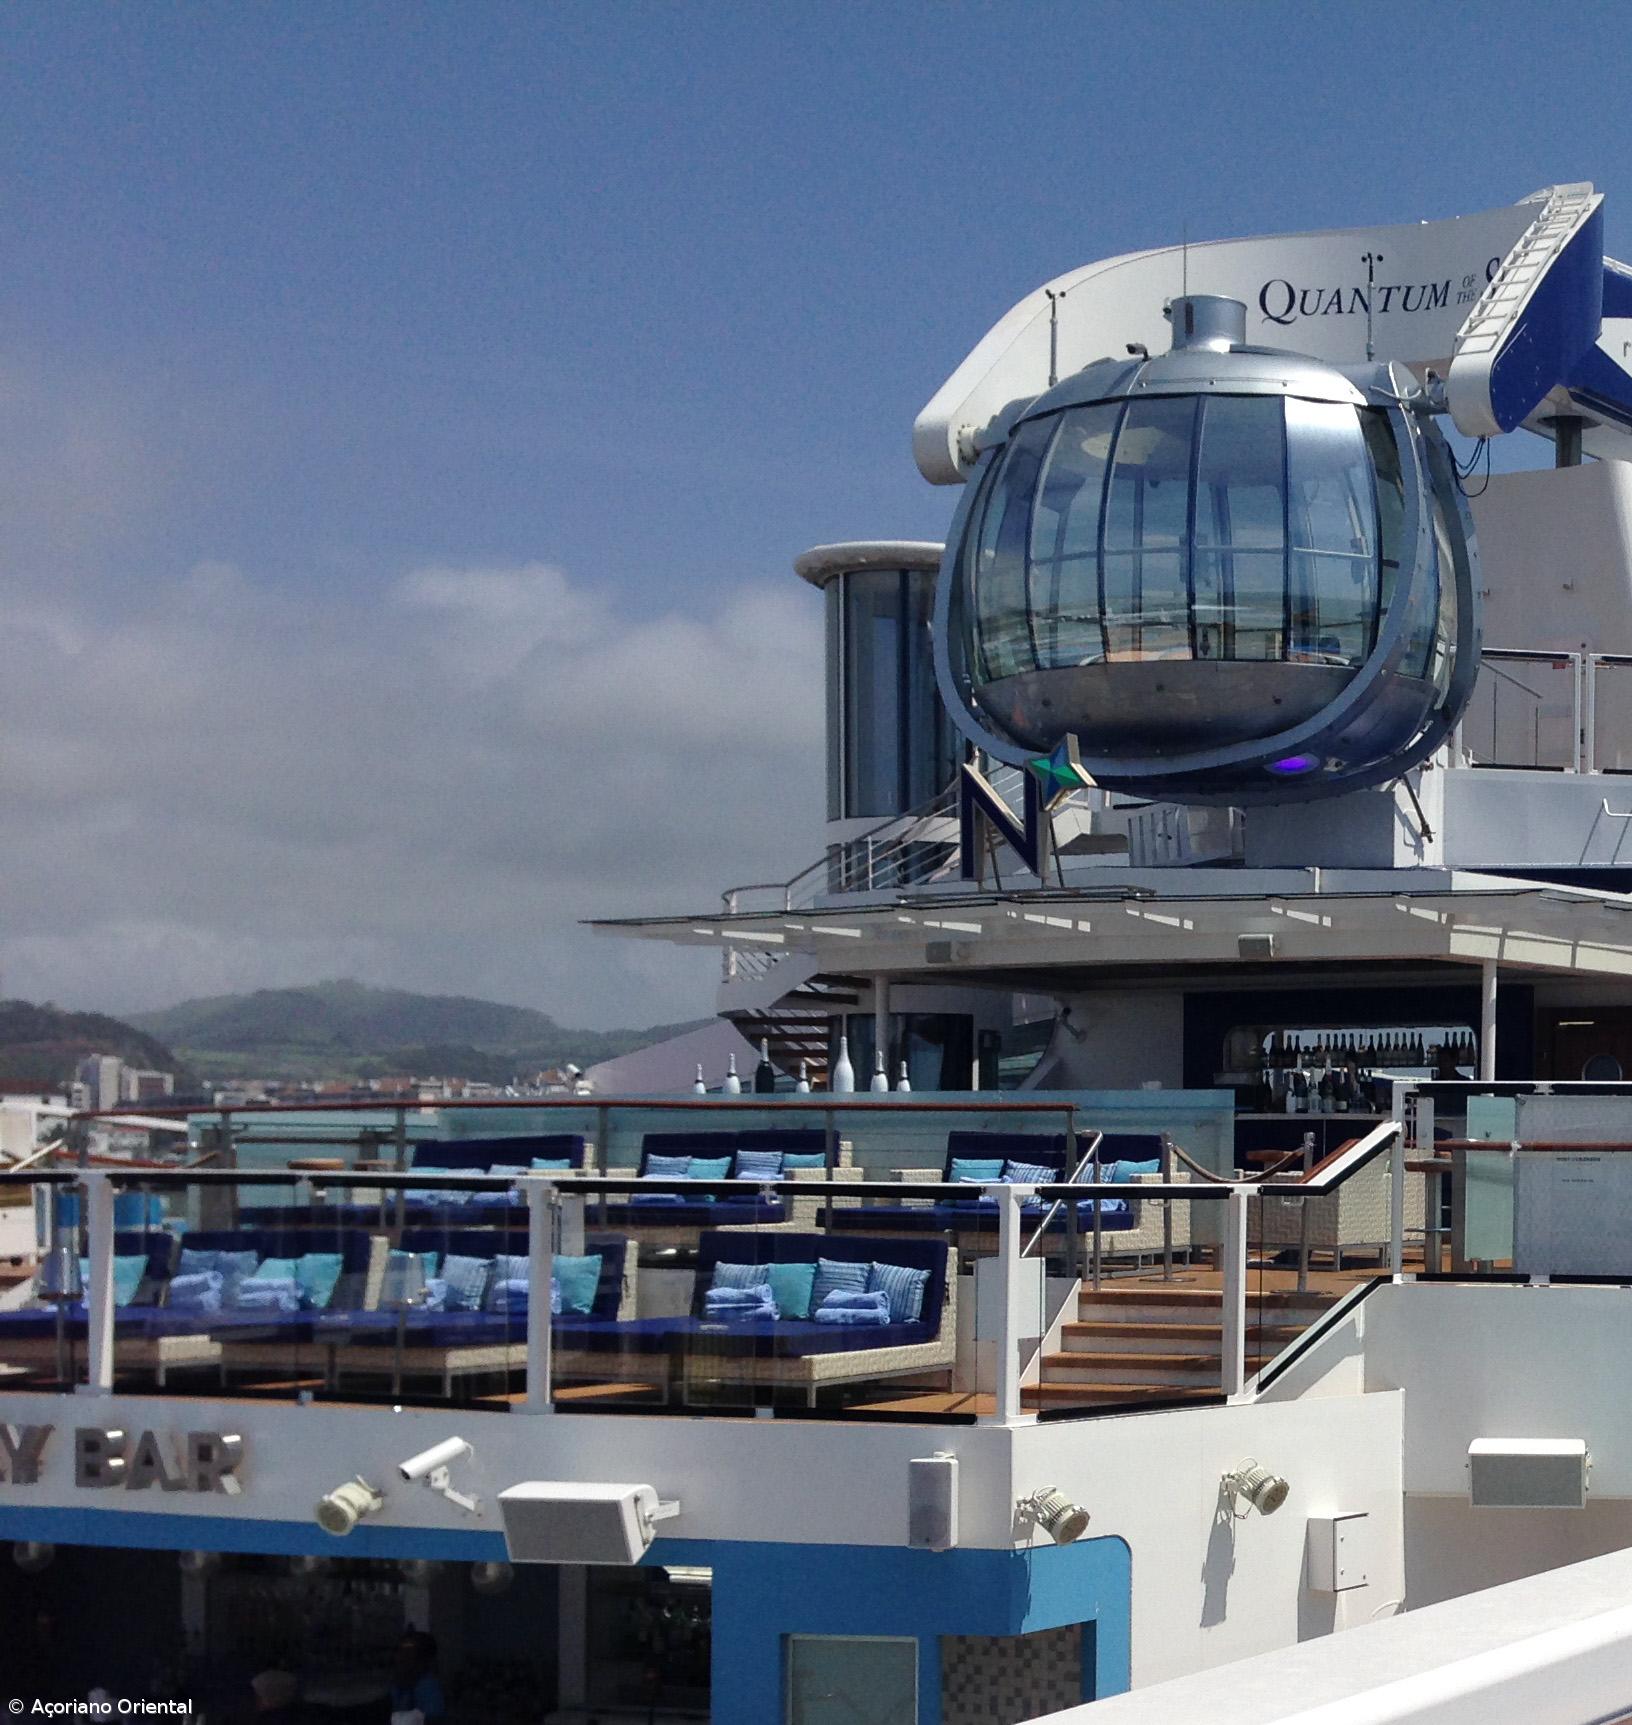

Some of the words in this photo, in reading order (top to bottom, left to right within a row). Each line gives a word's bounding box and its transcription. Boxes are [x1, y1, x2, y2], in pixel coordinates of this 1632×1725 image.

[1258, 279, 1452, 325] QUANTUM
[1462, 274, 1477, 289] OF
[0, 1424, 56, 1485] Y
[75, 1427, 244, 1495] BAR
